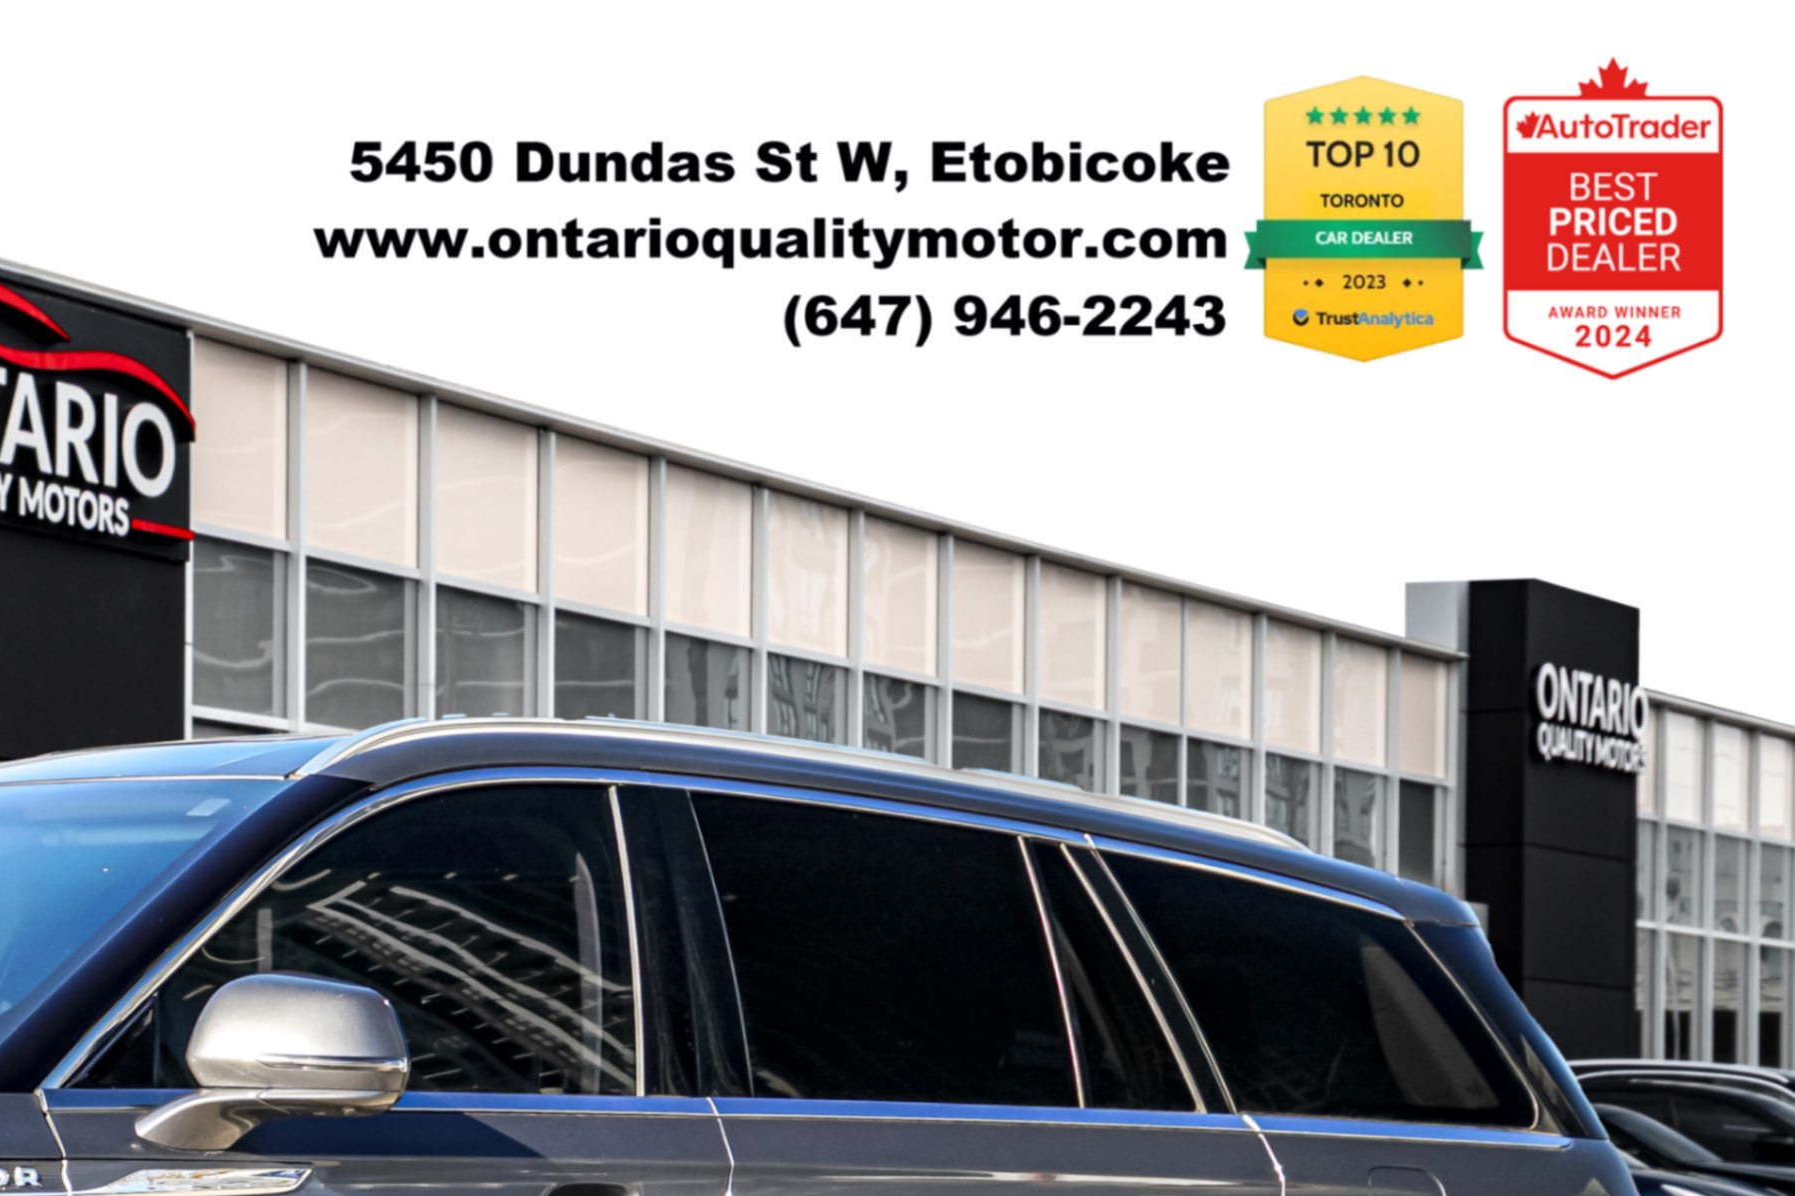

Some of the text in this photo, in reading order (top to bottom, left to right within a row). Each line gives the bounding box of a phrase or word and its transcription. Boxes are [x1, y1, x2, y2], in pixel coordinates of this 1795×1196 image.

[18, 475, 130, 537] MOTORS
[1536, 661, 1649, 741] ONTARIO
[1537, 721, 1647, 774] QUALITY MOTORS
